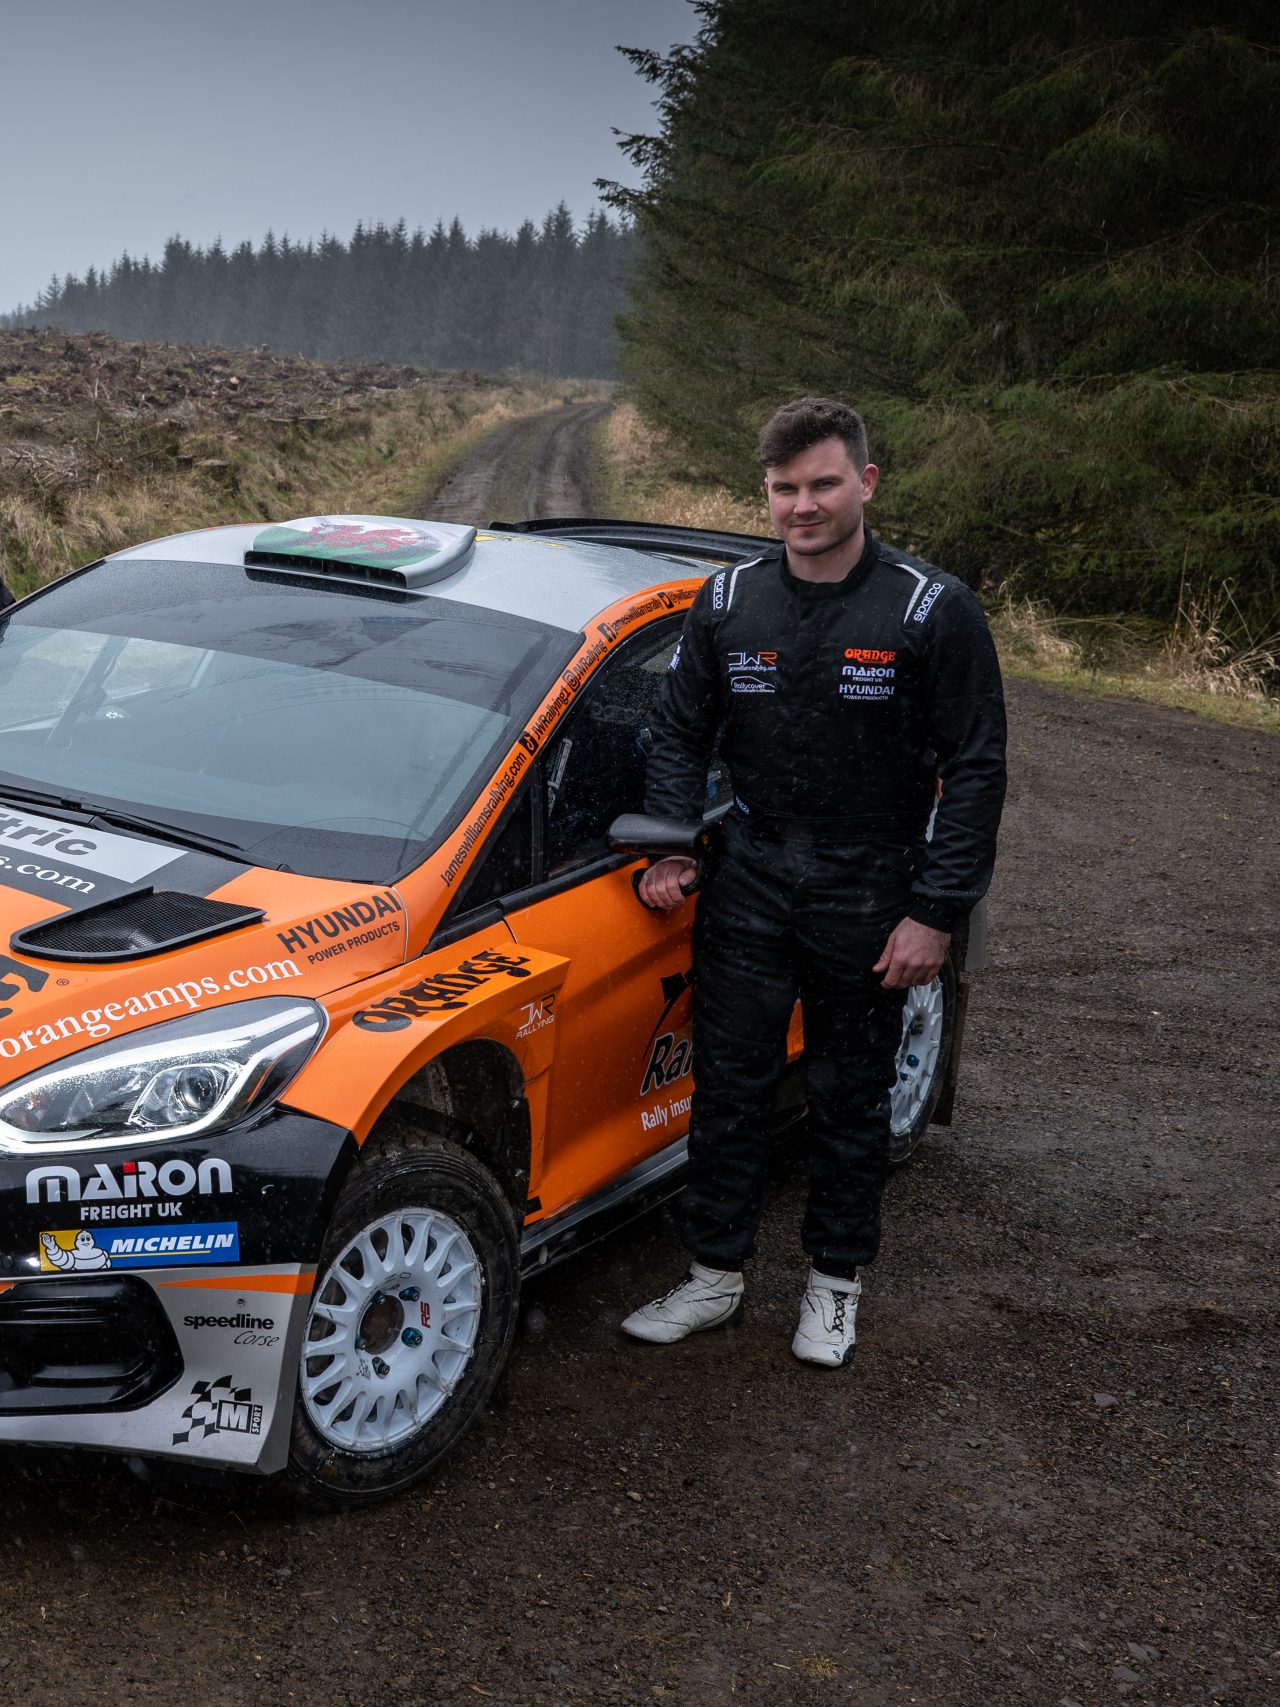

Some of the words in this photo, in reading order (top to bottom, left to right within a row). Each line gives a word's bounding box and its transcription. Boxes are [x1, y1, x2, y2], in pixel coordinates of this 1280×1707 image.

[714, 572, 726, 609] sparco
[913, 582, 942, 621] sparco
[728, 651, 778, 665] JWR
[844, 648, 896, 664] ORANGE
[839, 684, 895, 695] HYUNDAI
[277, 890, 402, 954] HYUNDAI
[307, 942, 347, 965] POWER
[347, 921, 400, 950] PRODUCTS
[352, 950, 532, 1033] ORANGE
[519, 993, 555, 1031] JWR
[515, 1014, 555, 1040] RALLYING
[640, 1103, 668, 1131] Rally
[669, 1095, 692, 1118] insu
[80, 1204, 153, 1221] FREIGHT
[157, 1202, 183, 1217] UK
[110, 1233, 235, 1254] MICHELIN
[183, 1313, 275, 1330] speedline
[233, 1330, 280, 1347] Corse
[251, 1406, 262, 1433] SPORT
